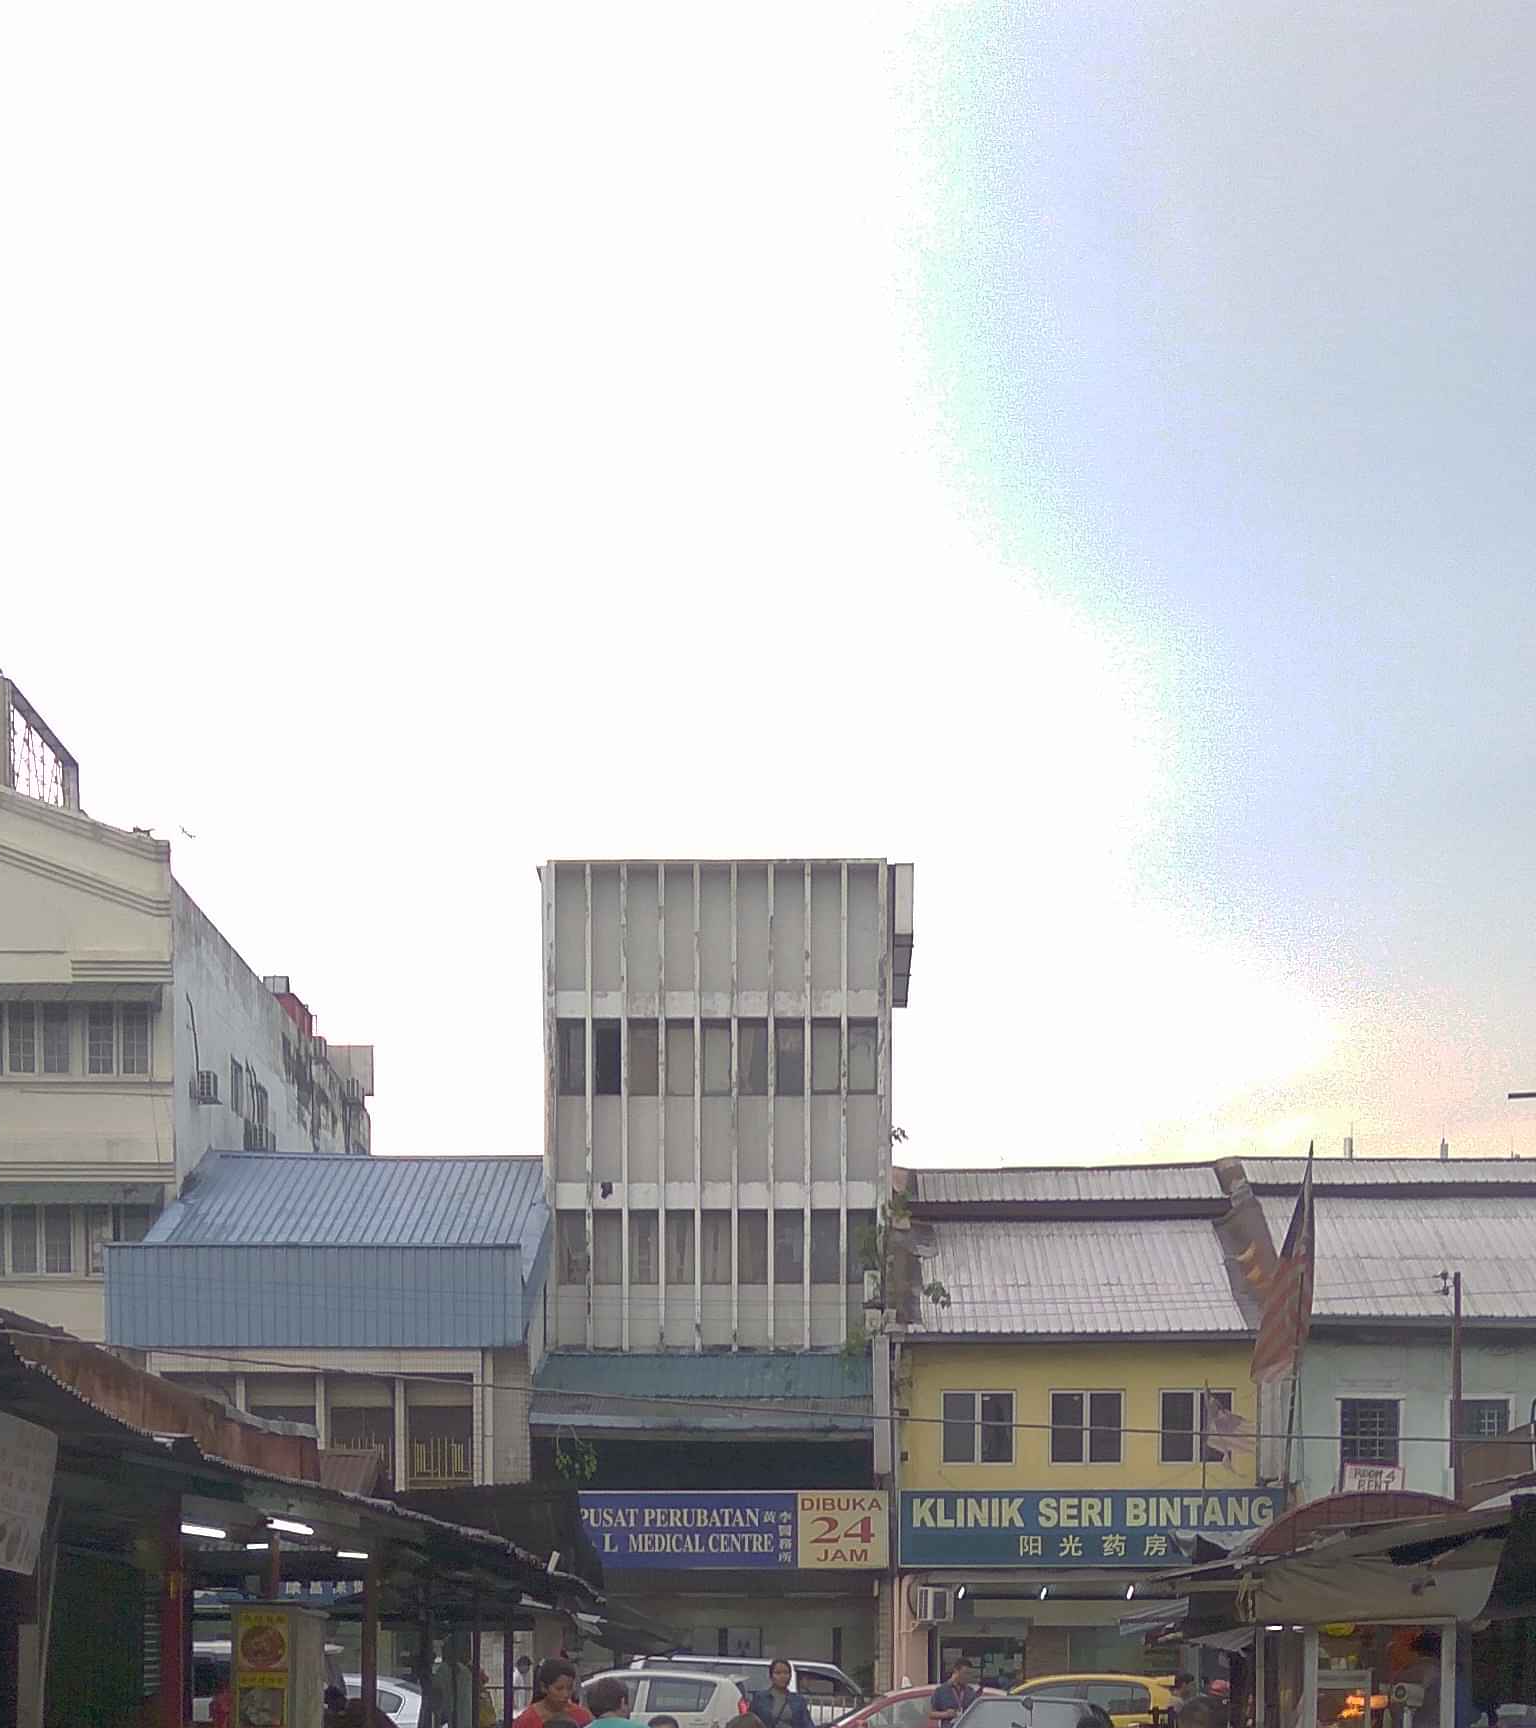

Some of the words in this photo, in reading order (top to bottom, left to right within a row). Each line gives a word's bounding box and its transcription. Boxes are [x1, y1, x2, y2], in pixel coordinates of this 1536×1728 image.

[1384, 1470, 1395, 1482] 4
[800, 1497, 882, 1512] DIBUKA
[911, 1497, 1025, 1529] KLINIK
[1037, 1496, 1112, 1528] SERI
[1125, 1496, 1276, 1528] BINTANG
[644, 1507, 760, 1528] PERUBATAN
[809, 1516, 875, 1545] 24
[628, 1532, 704, 1553] MEDICAL
[708, 1532, 775, 1553] CENTRE
[1018, 1533, 1169, 1558] 阳光药房
[816, 1548, 869, 1563] JAM
